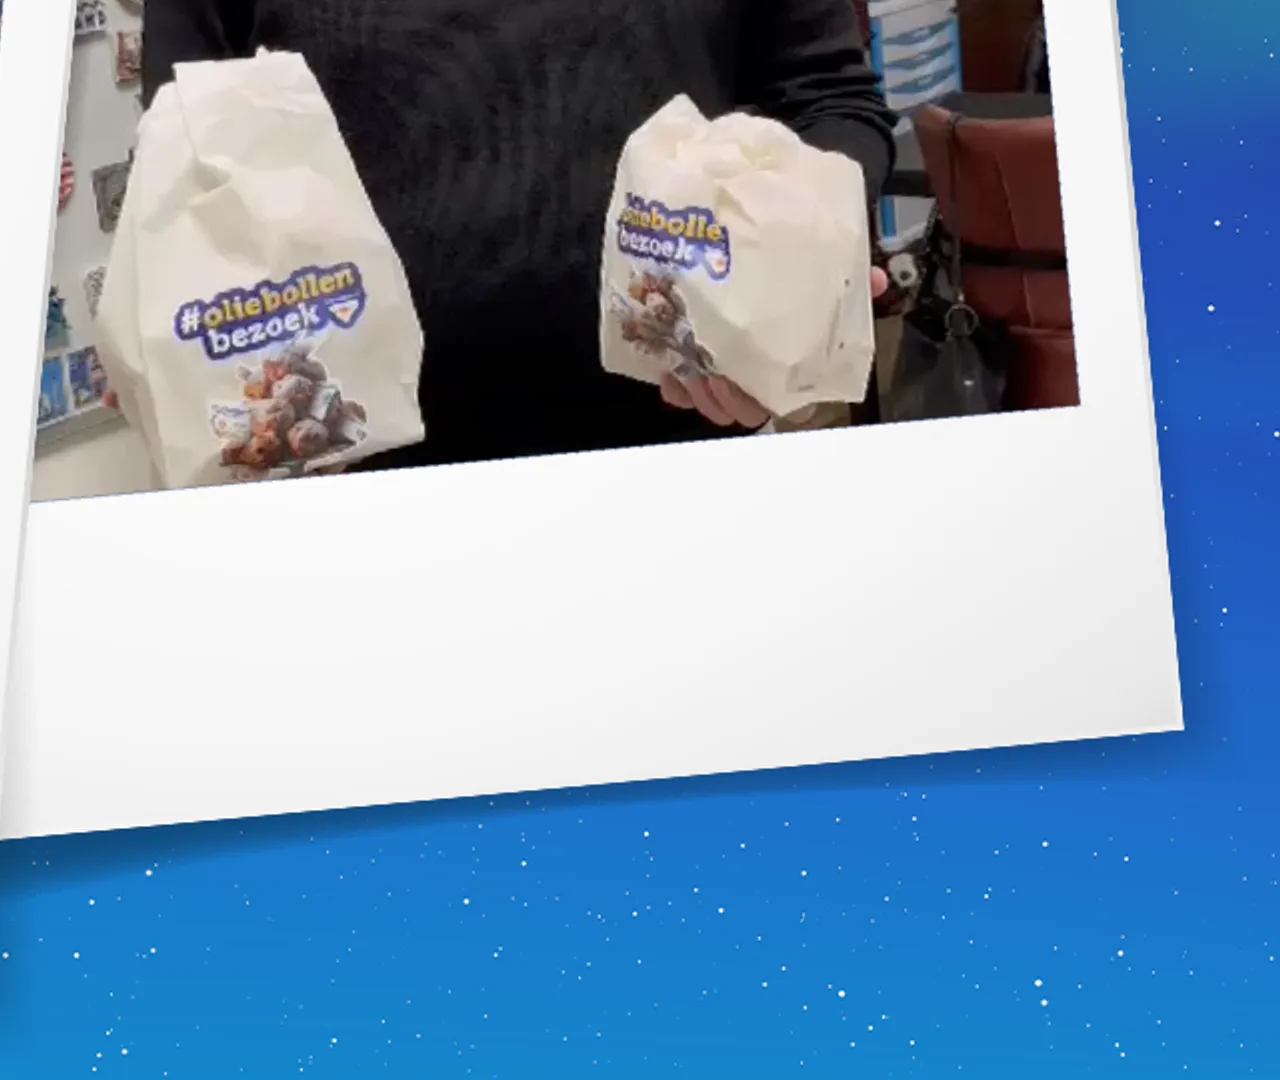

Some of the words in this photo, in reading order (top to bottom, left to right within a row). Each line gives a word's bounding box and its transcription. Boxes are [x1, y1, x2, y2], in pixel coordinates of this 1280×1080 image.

[620, 225, 694, 261] bezoek
[179, 267, 354, 335] #oliebollen
[208, 302, 321, 353] bezoek
